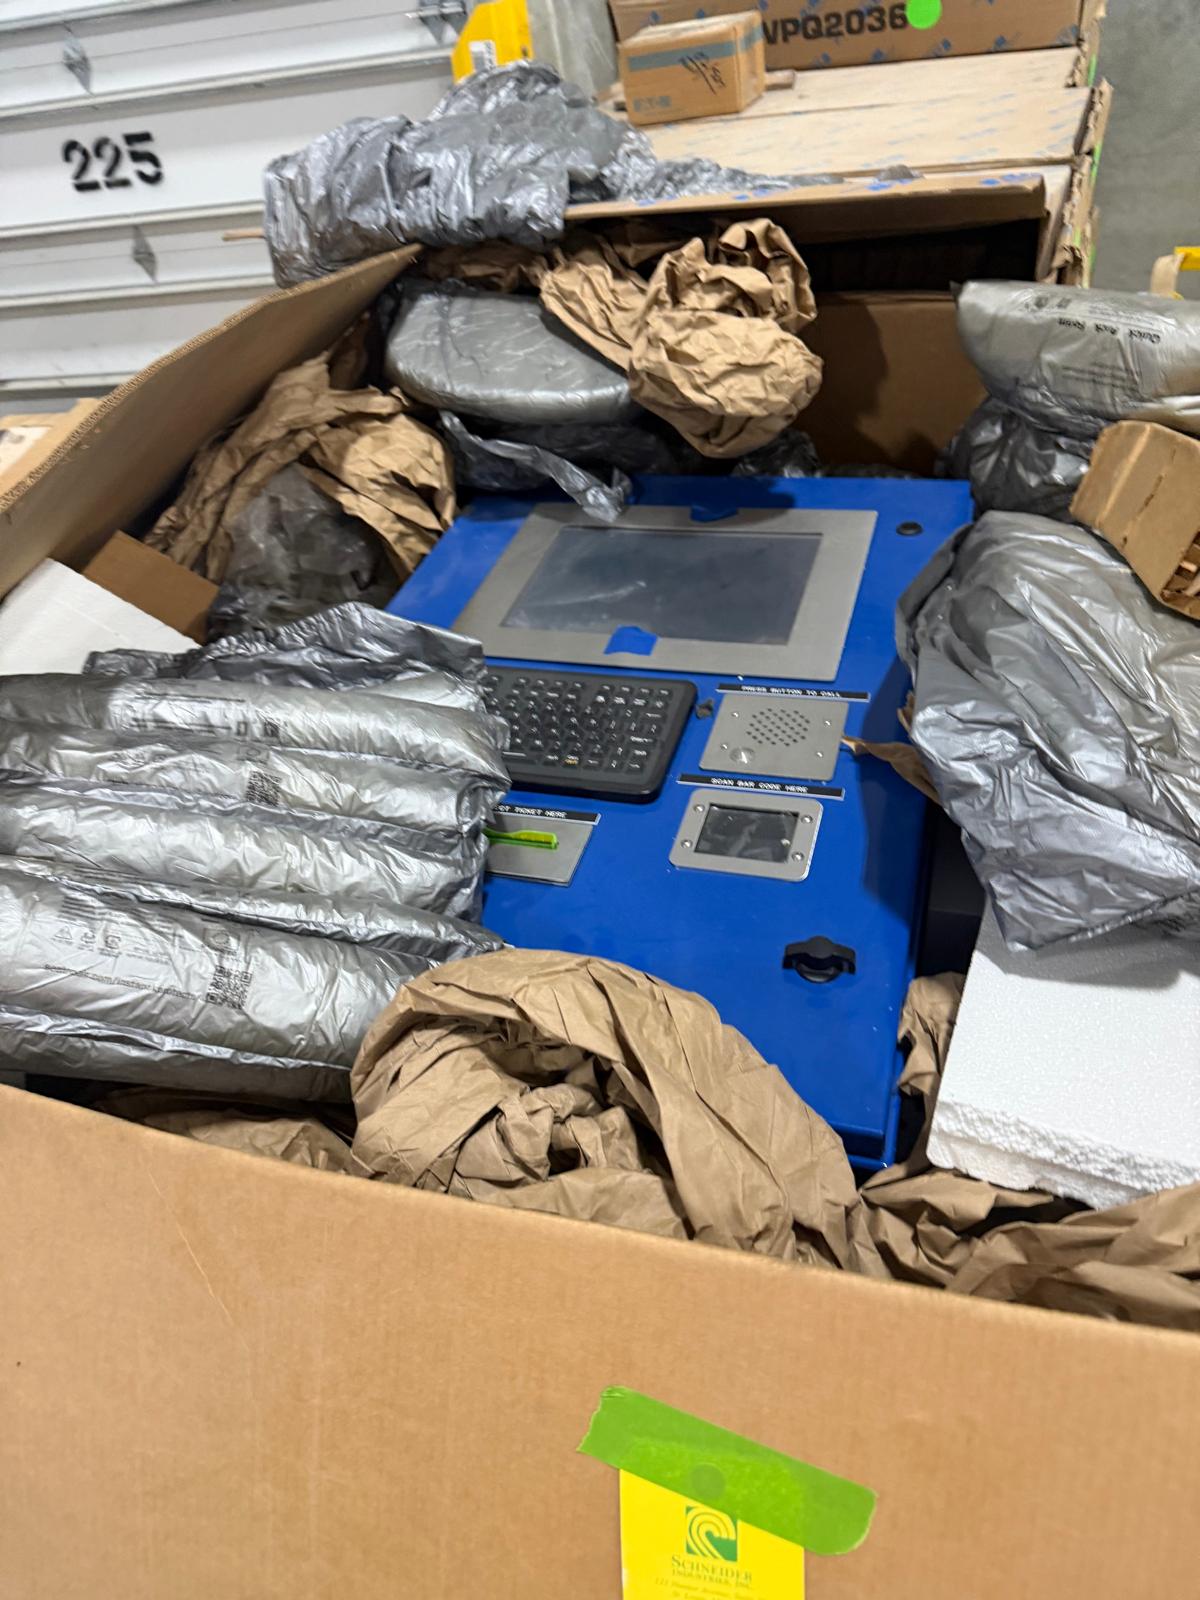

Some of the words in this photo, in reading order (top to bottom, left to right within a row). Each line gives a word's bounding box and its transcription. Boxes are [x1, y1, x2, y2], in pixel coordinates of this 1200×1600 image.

[63, 132, 163, 191] 225
[710, 777, 734, 787] SCAN
[736, 780, 755, 788] BAR
[758, 783, 782, 791] CODE
[785, 785, 807, 793] HERE
[544, 809, 567, 819] HERE
